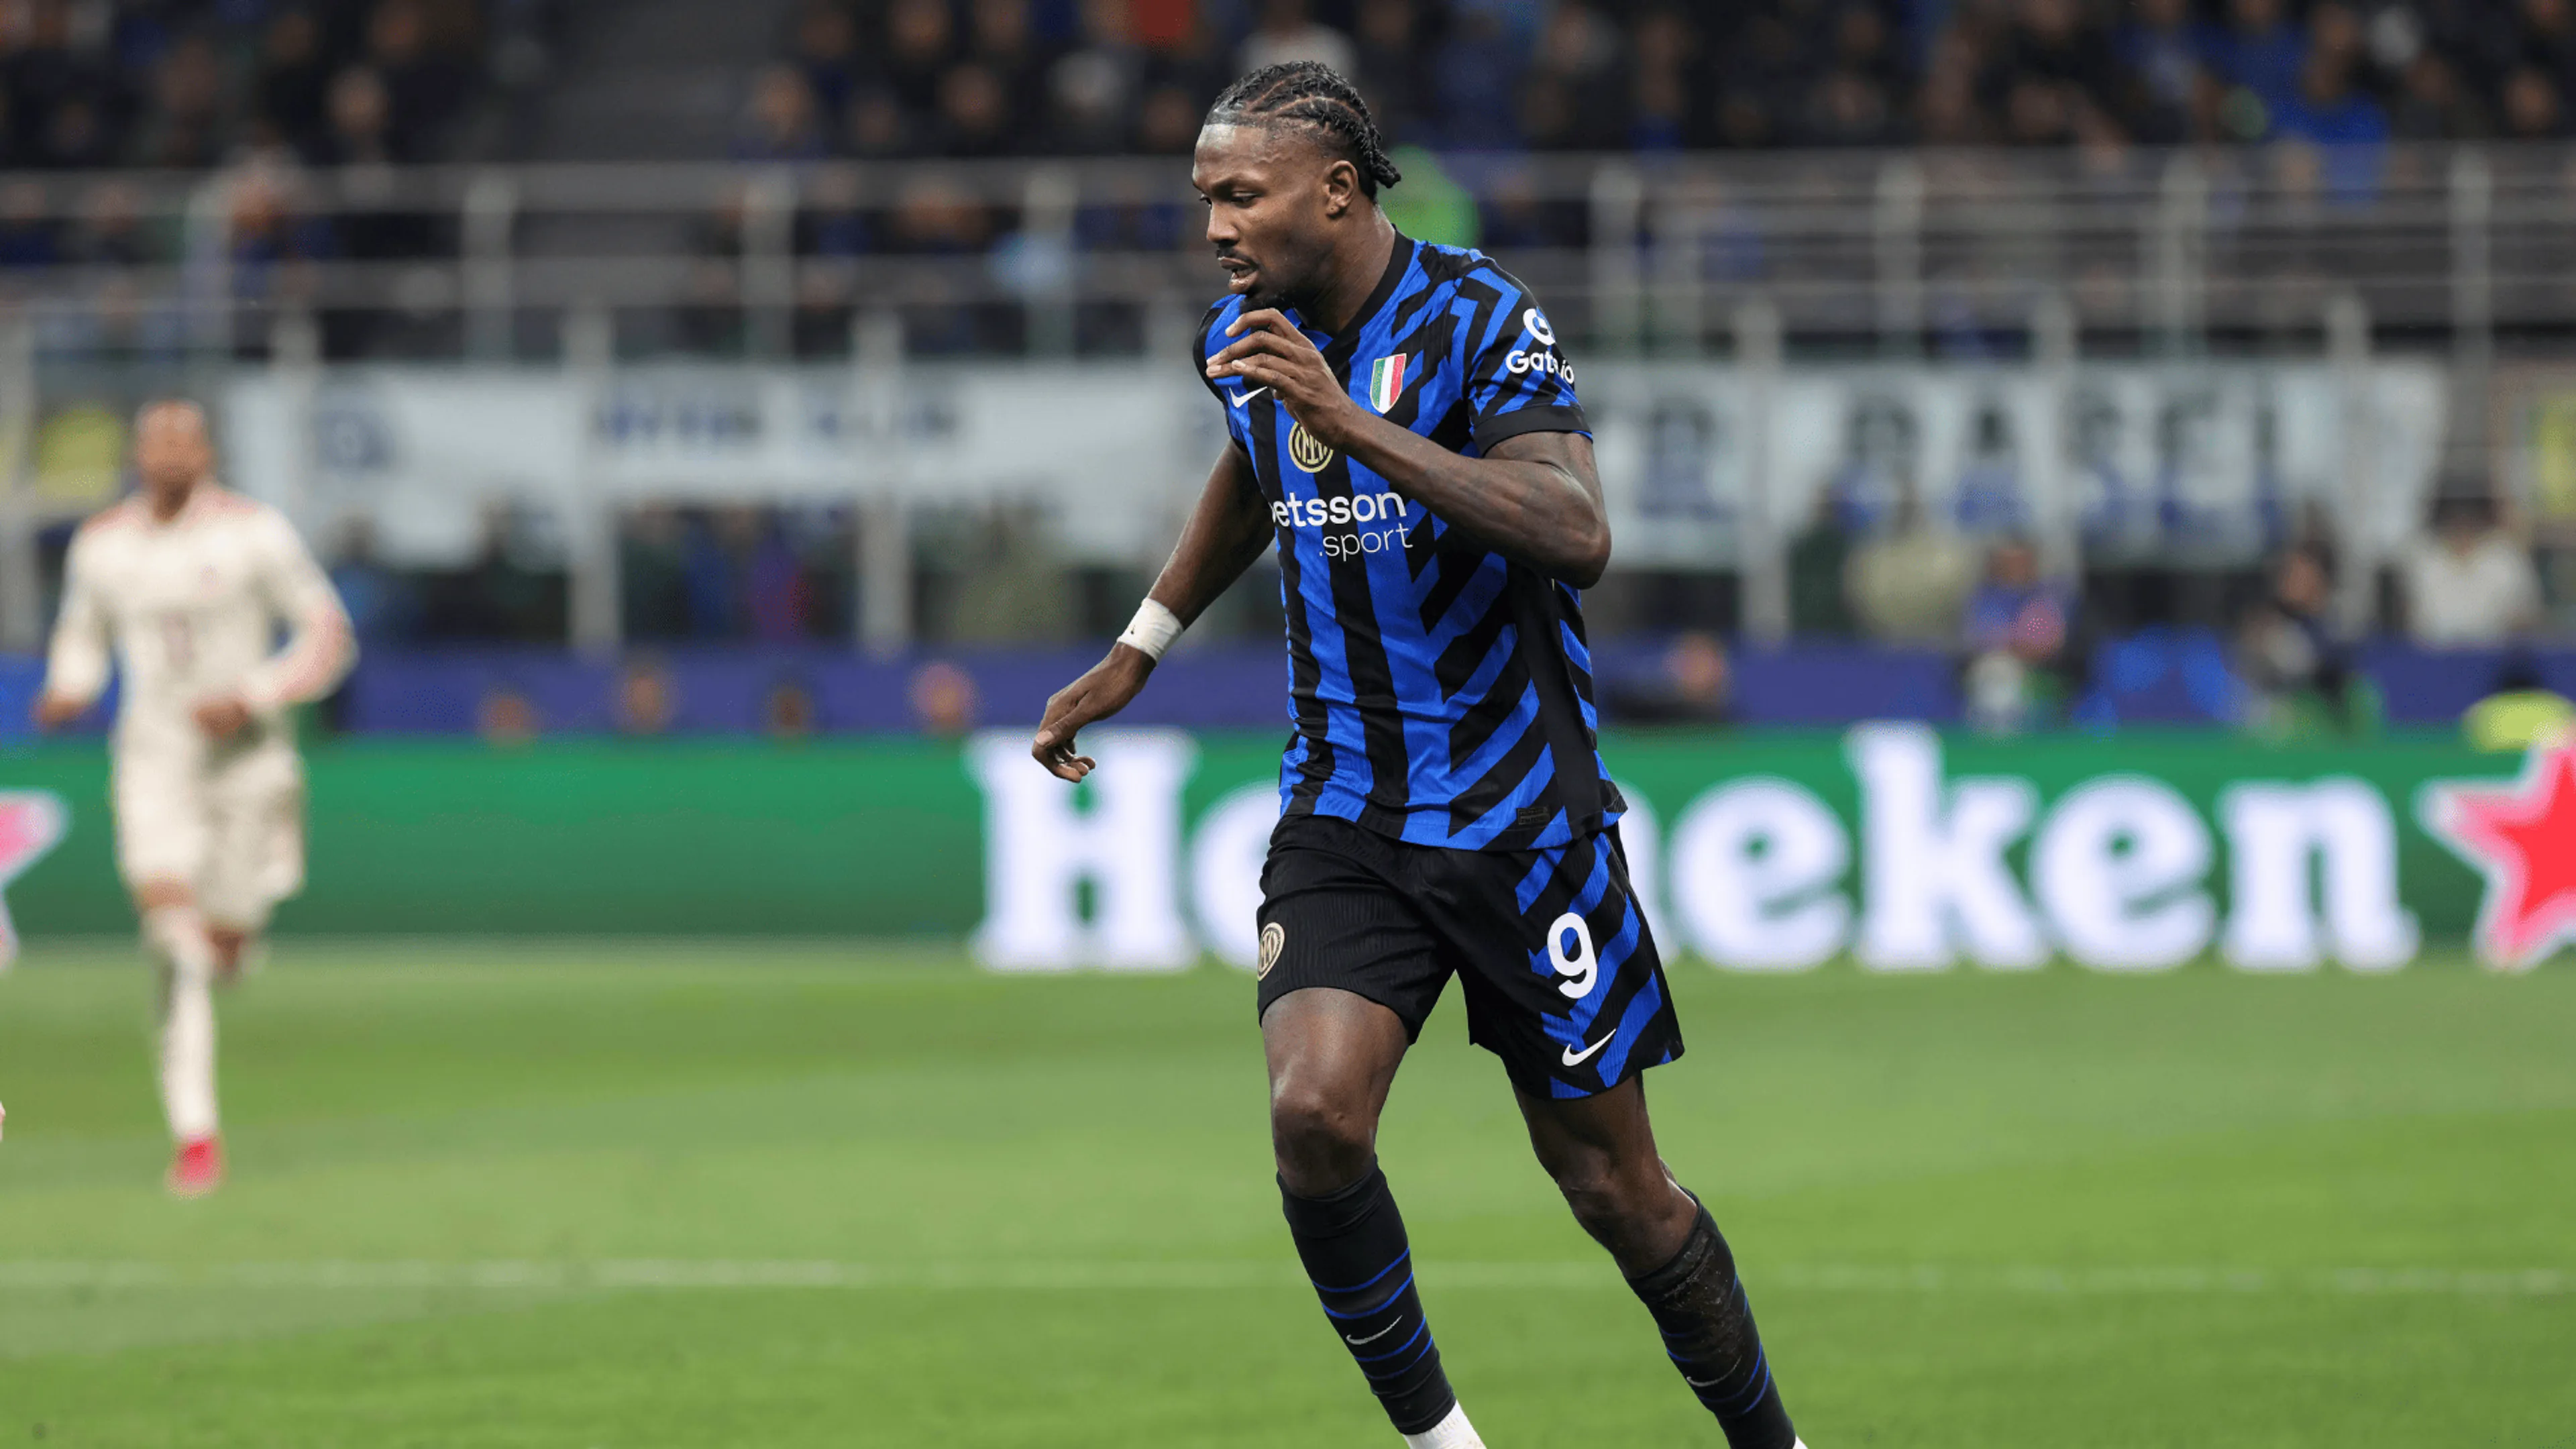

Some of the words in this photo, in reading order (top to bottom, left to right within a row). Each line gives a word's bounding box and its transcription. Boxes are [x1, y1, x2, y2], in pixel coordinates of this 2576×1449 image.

[1271, 492, 1407, 527] etsson
[1319, 523, 1413, 561] .sport
[976, 726, 2415, 973] Heken
[1547, 912, 1598, 999] 9
